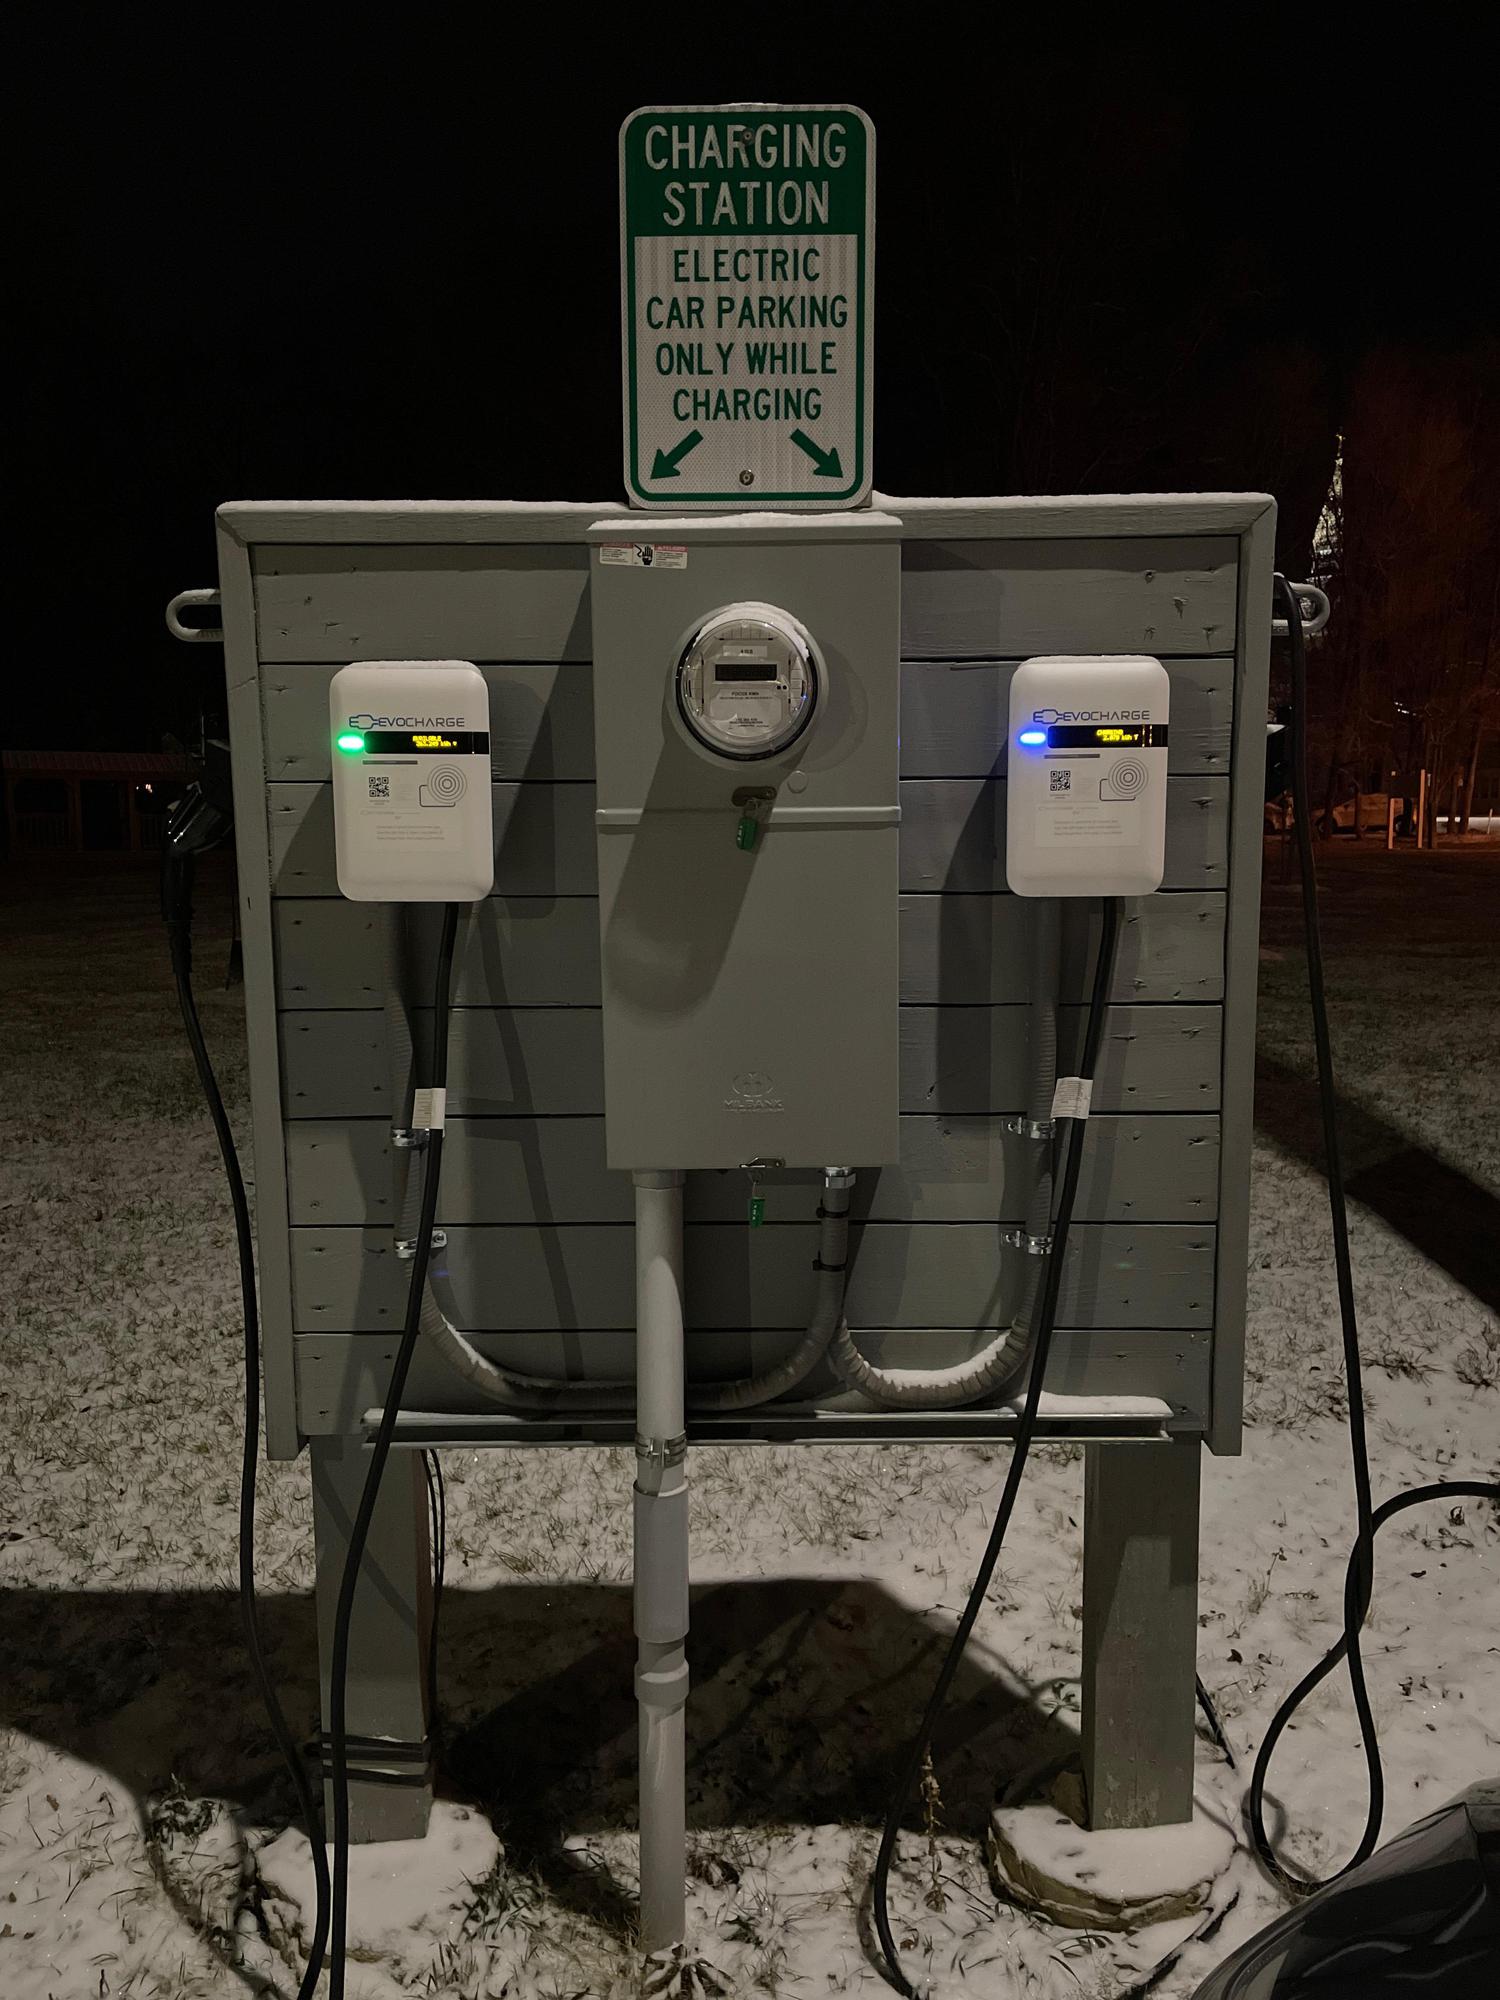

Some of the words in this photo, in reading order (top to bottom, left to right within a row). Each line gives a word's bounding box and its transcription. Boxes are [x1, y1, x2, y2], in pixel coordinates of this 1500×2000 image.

[645, 122, 847, 170] CHARGING
[663, 180, 829, 226] STATION
[673, 248, 821, 283] ELECTRIC
[646, 296, 705, 330] CAR
[717, 295, 848, 329] PARKING
[656, 342, 735, 376] ONLY
[746, 341, 838, 375] WHILE
[673, 388, 823, 421] CHARGING
[378, 717, 465, 727] EVOCHARGE
[1063, 710, 1150, 721] EVOCHARGE
